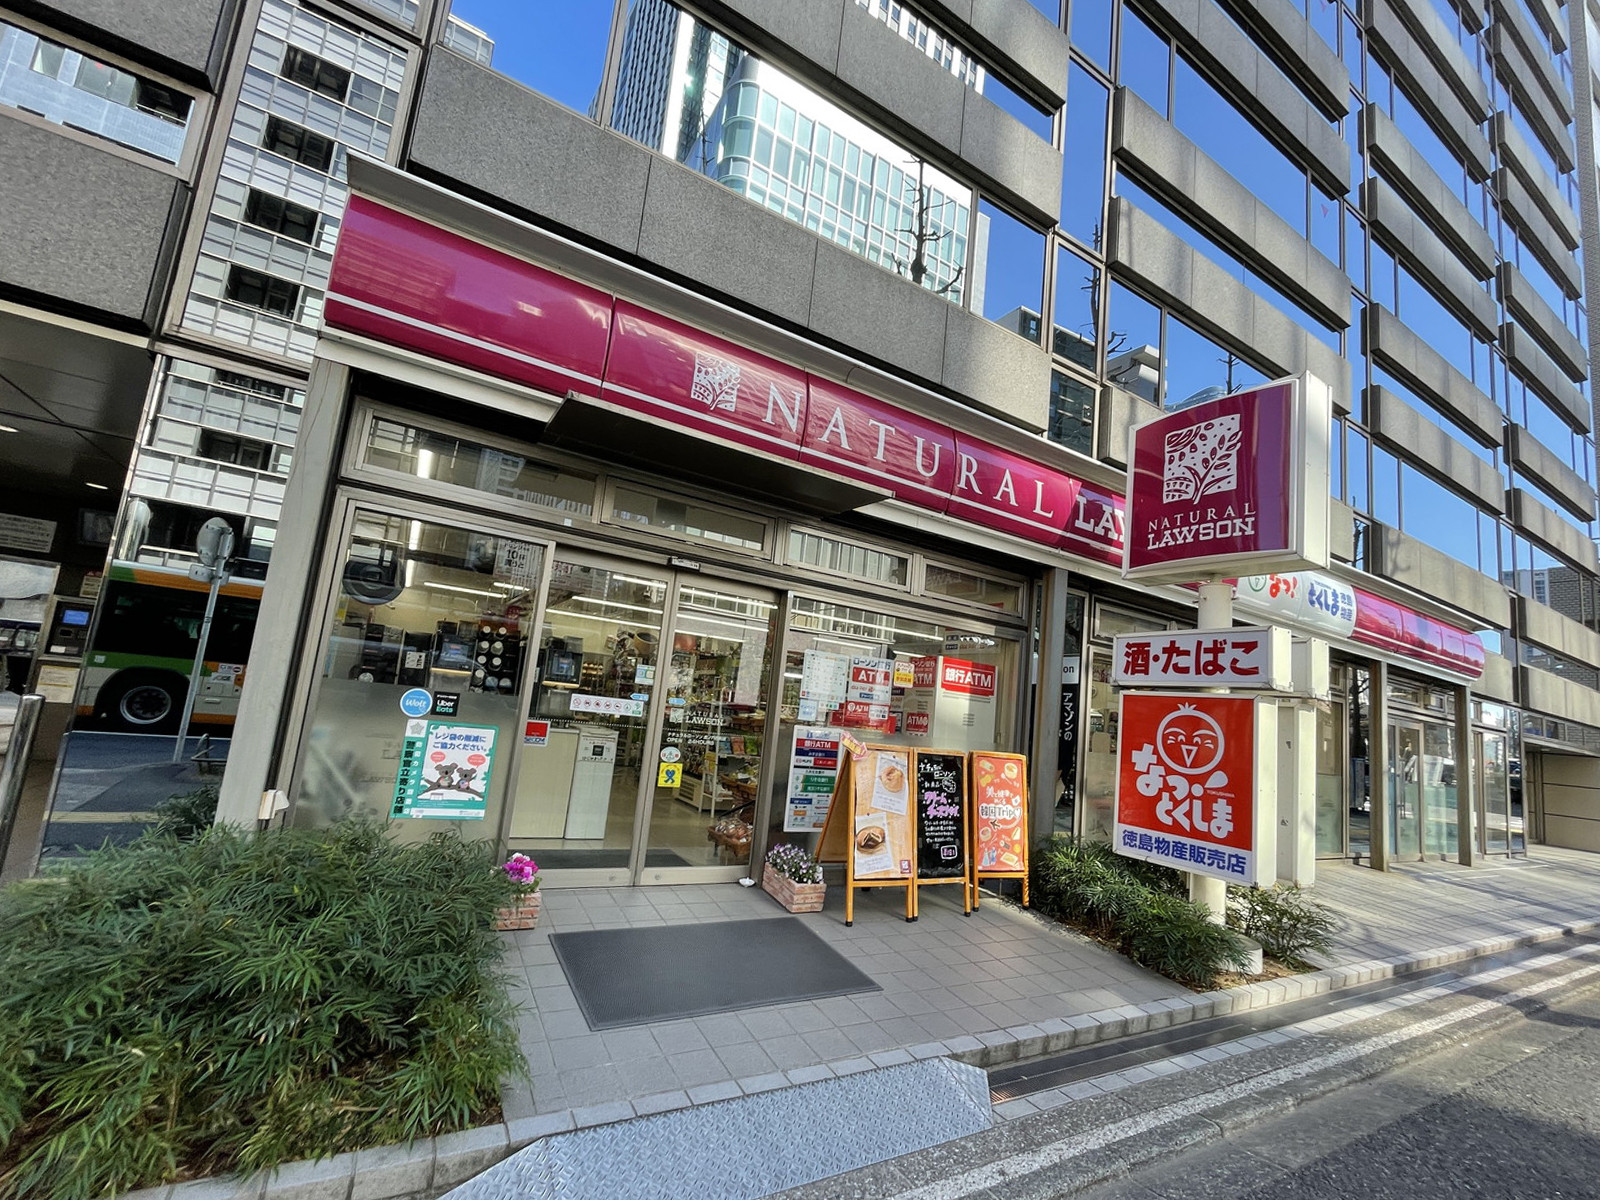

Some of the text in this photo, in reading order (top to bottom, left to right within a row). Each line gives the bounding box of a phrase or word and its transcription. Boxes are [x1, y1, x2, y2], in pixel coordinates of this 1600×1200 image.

[761, 382, 1054, 518] NATURAL
[1148, 502, 1256, 532] NATURAL
[1147, 516, 1256, 551] LAWSON
[1308, 582, 1340, 616] とくしま
[858, 669, 885, 684] ATM
[945, 667, 992, 688] 銀行ATM
[405, 699, 427, 707] Wolt
[685, 716, 724, 726] LAWSON
[686, 710, 723, 718] NATURAL
[1062, 692, 1075, 741] アマゾンの
[433, 741, 487, 752] ご協力ください。
[435, 732, 487, 743] レジ袋の削減に
[804, 740, 831, 749] 銀行ATM
[1155, 792, 1233, 839] とくしま
[1122, 829, 1247, 876] 徳島物産販売店
